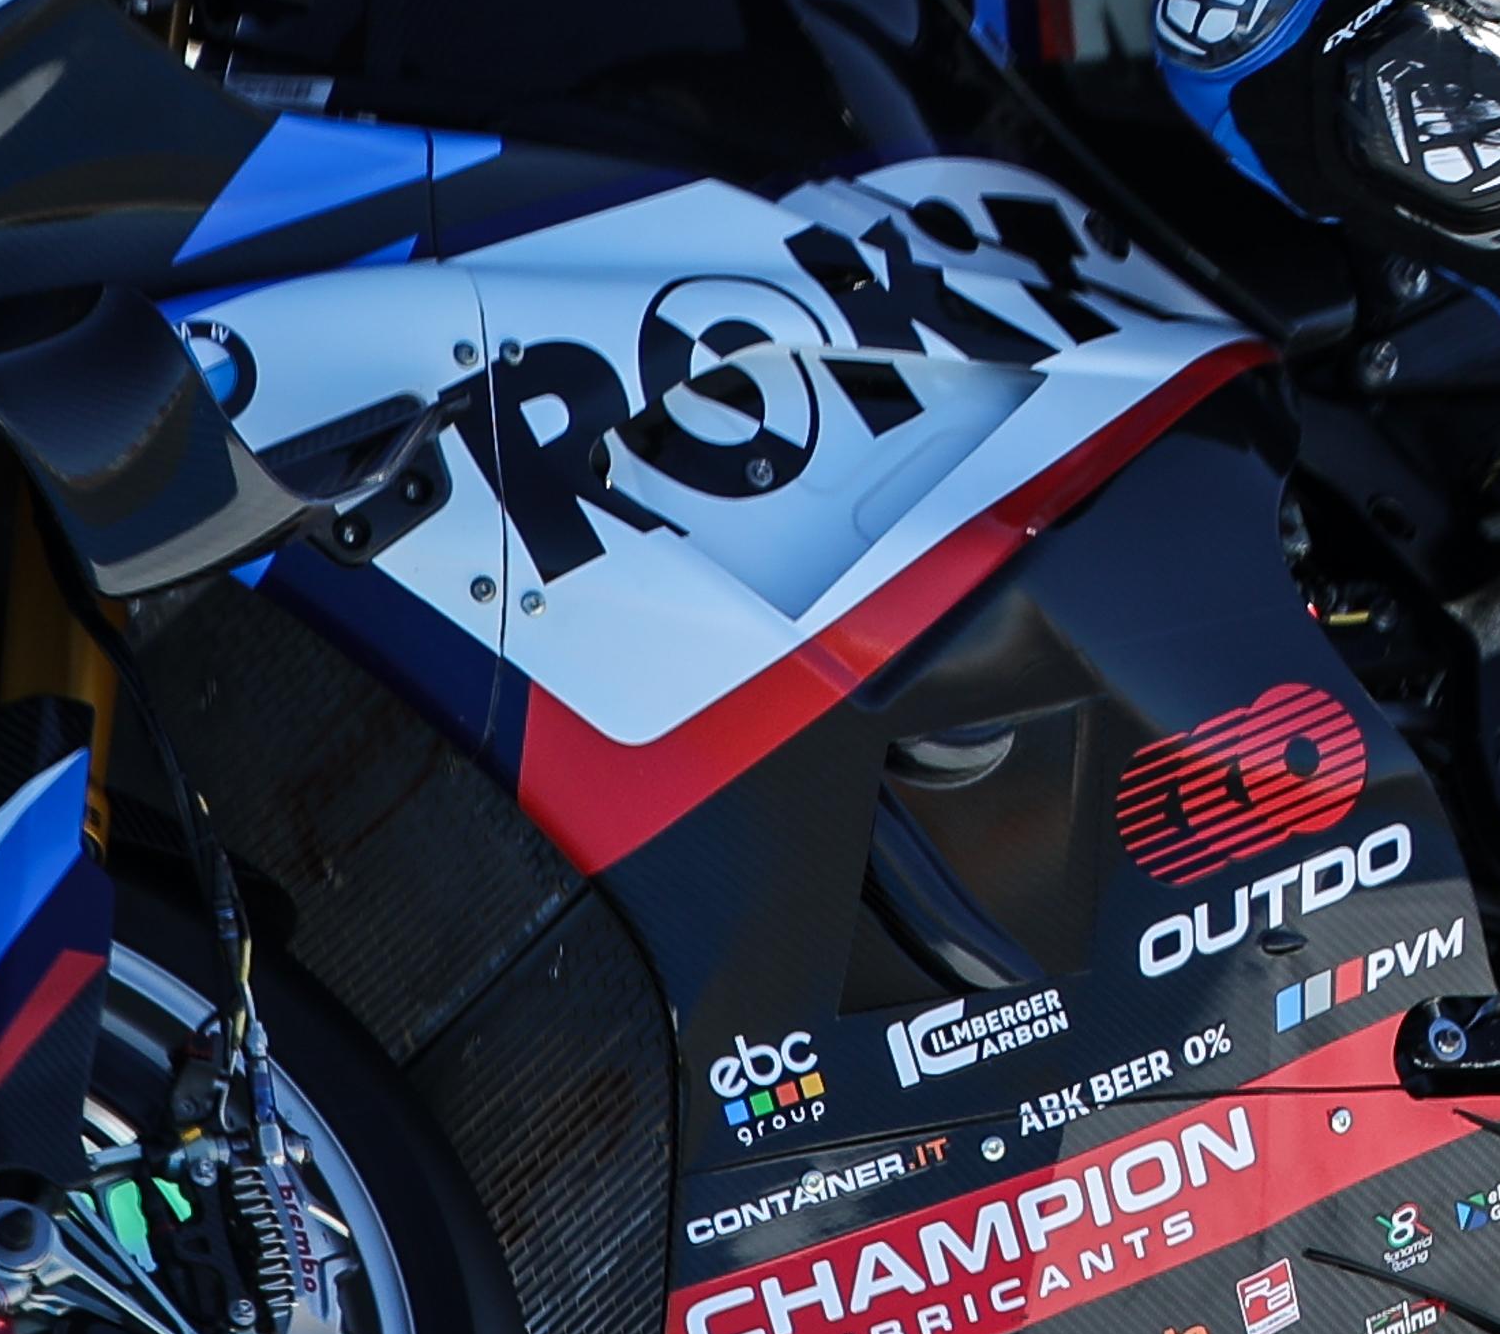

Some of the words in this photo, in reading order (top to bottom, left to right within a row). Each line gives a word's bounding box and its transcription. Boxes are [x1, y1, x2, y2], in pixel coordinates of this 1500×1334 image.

[1138, 822, 1412, 979] OUTDO
[1366, 917, 1464, 993] PVM
[929, 988, 1063, 1054] ILMBERGER
[709, 1030, 819, 1098] ebc
[1018, 1082, 1091, 1137] ABK
[1089, 1049, 1173, 1111] BEER
[1182, 1022, 1232, 1067] 0%
[736, 1100, 826, 1147] group
[277, 1184, 320, 1294] brembo
